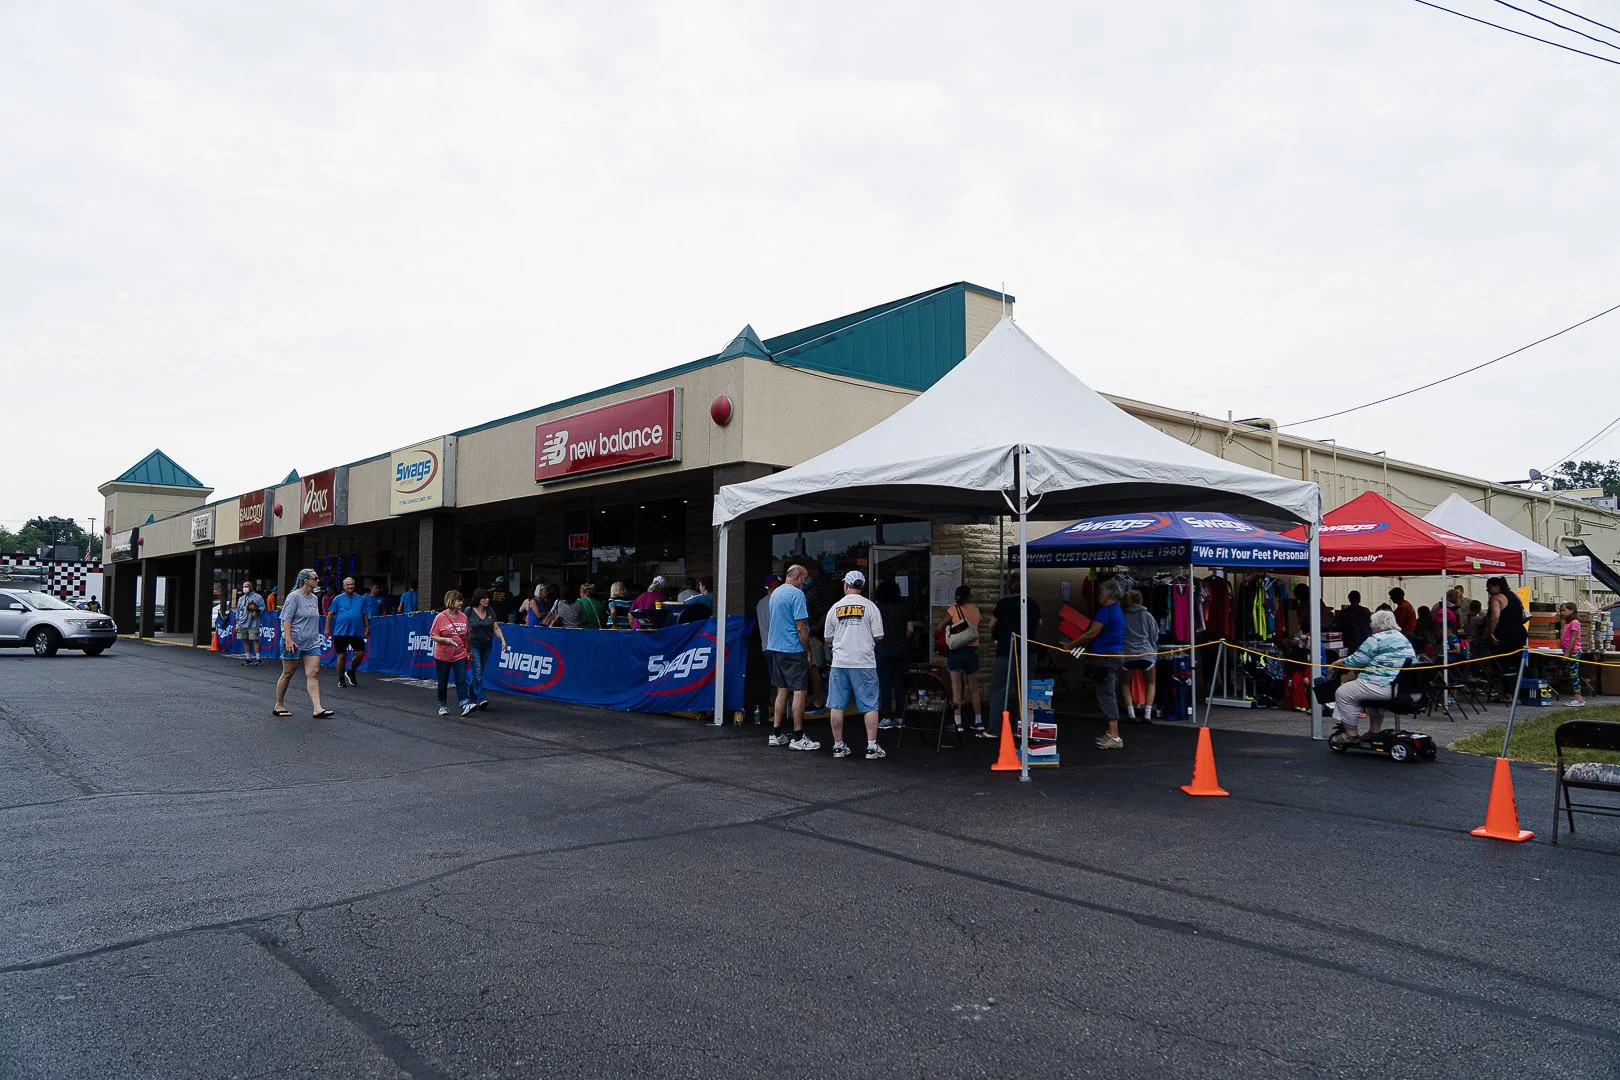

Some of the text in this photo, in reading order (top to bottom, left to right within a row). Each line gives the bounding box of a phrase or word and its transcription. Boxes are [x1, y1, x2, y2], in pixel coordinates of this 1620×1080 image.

[569, 439, 597, 461] new
[599, 424, 663, 455] balance
[396, 459, 432, 482] Swags
[1064, 519, 1156, 534] Swags
[1182, 517, 1253, 532] Swags
[1055, 551, 1118, 562] CUSTOMERS
[1121, 547, 1155, 560] SINCE
[1157, 545, 1187, 558] 1980
[1215, 547, 1229, 559] Fit
[1230, 548, 1251, 560] Your
[1252, 548, 1272, 560] Feet
[407, 630, 435, 657] Swag
[498, 645, 553, 680] Swags
[647, 646, 712, 682] Swags
